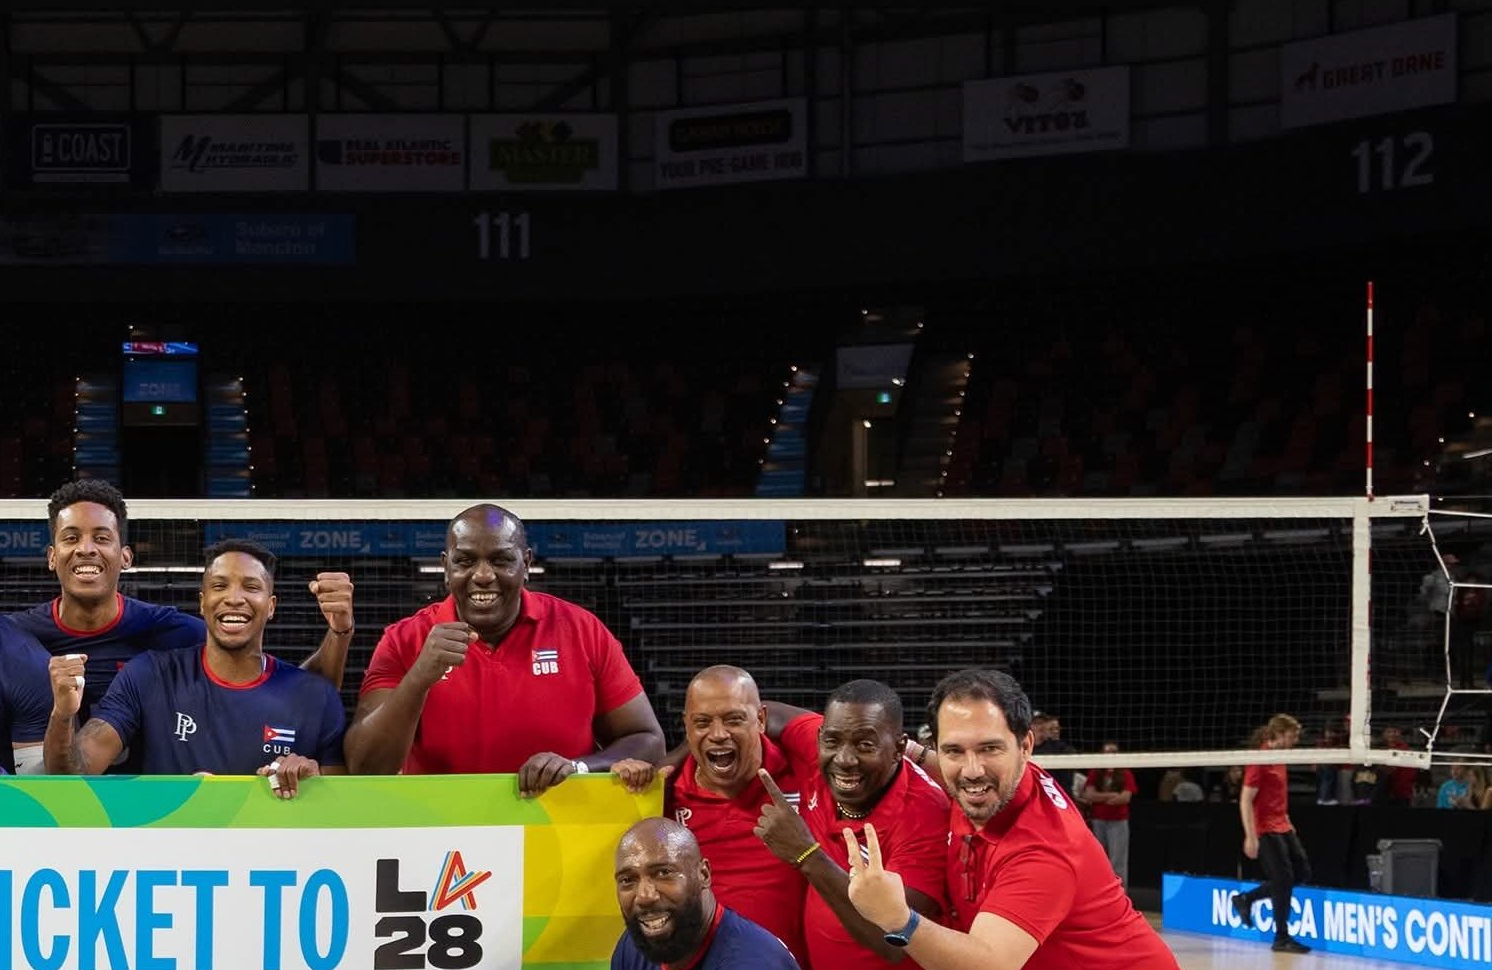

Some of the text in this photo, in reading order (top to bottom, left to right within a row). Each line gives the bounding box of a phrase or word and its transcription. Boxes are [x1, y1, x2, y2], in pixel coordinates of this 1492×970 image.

[1323, 62, 1388, 89] GREAT
[59, 133, 124, 162] COAST
[347, 151, 460, 165] SUPERSTORE
[1350, 131, 1435, 193] 112
[473, 212, 530, 259] 111
[299, 531, 362, 549] ZONE
[635, 529, 698, 549] ZONE
[532, 661, 560, 676] CUB
[263, 743, 291, 756] CUB
[375, 851, 493, 913] LA
[1212, 888, 1492, 963] NOCCA MEN'S CONTI
[374, 913, 484, 970] 28
